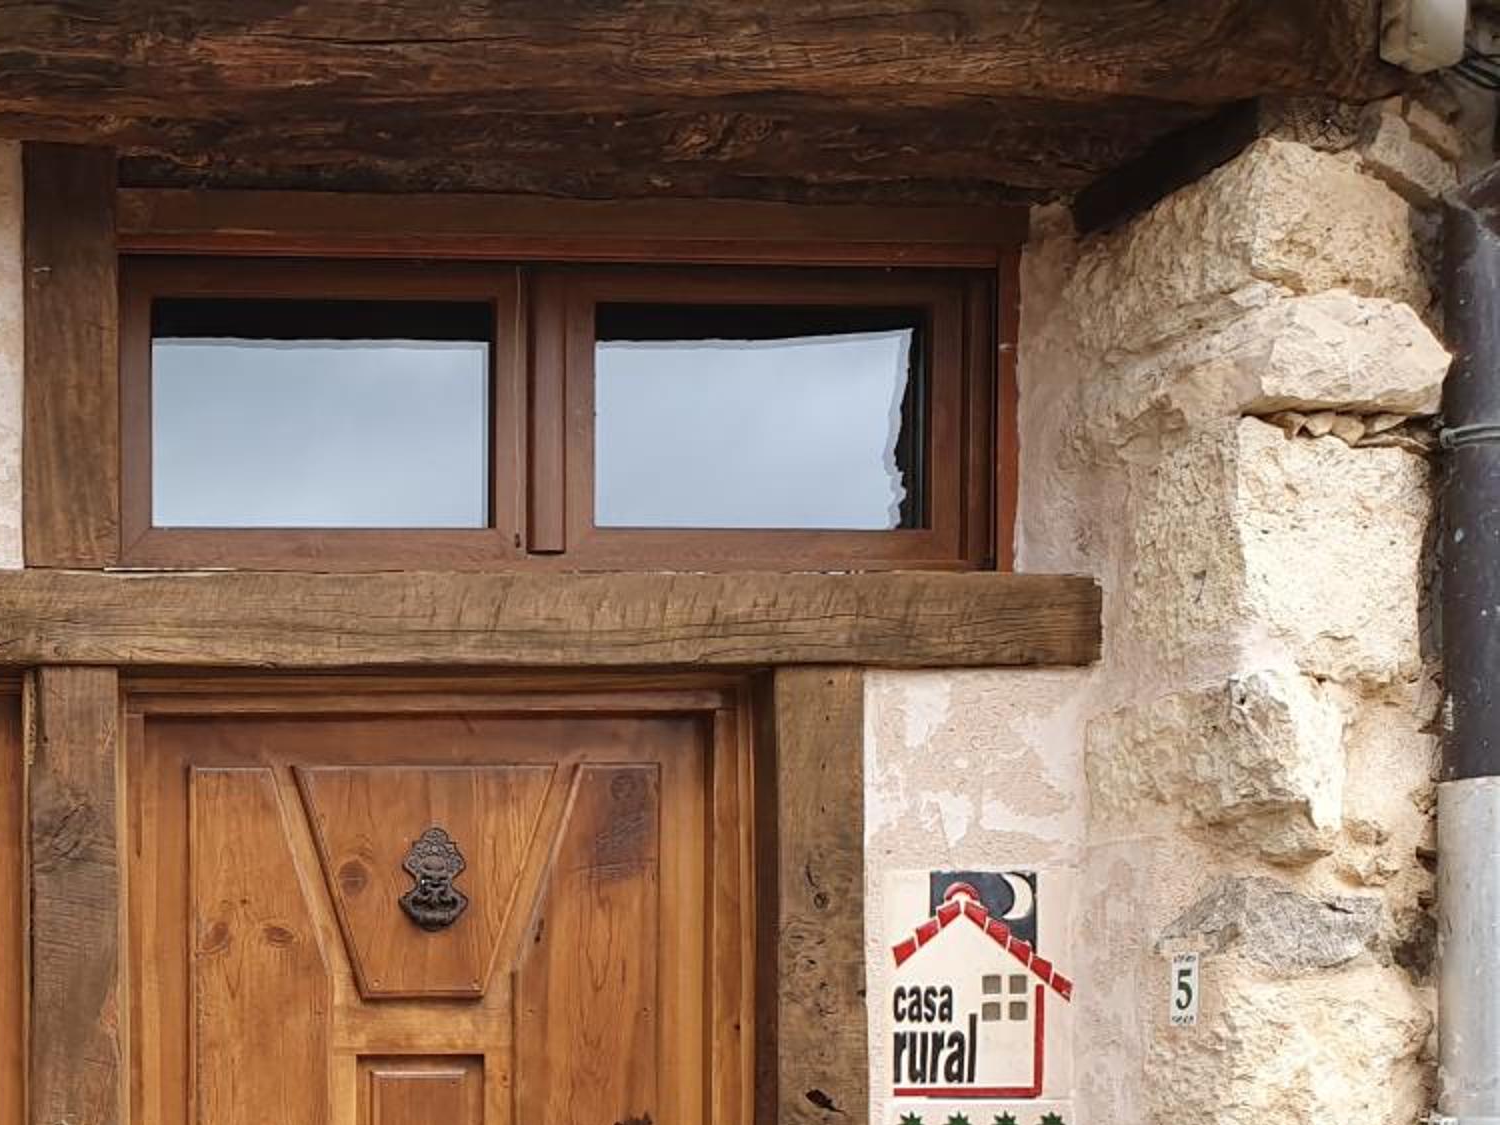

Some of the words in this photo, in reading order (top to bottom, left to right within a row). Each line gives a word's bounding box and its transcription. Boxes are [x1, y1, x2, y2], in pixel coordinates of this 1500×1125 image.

[893, 985, 953, 1023] casa
[1176, 969, 1193, 1011] 5
[893, 1013, 977, 1084] rural
